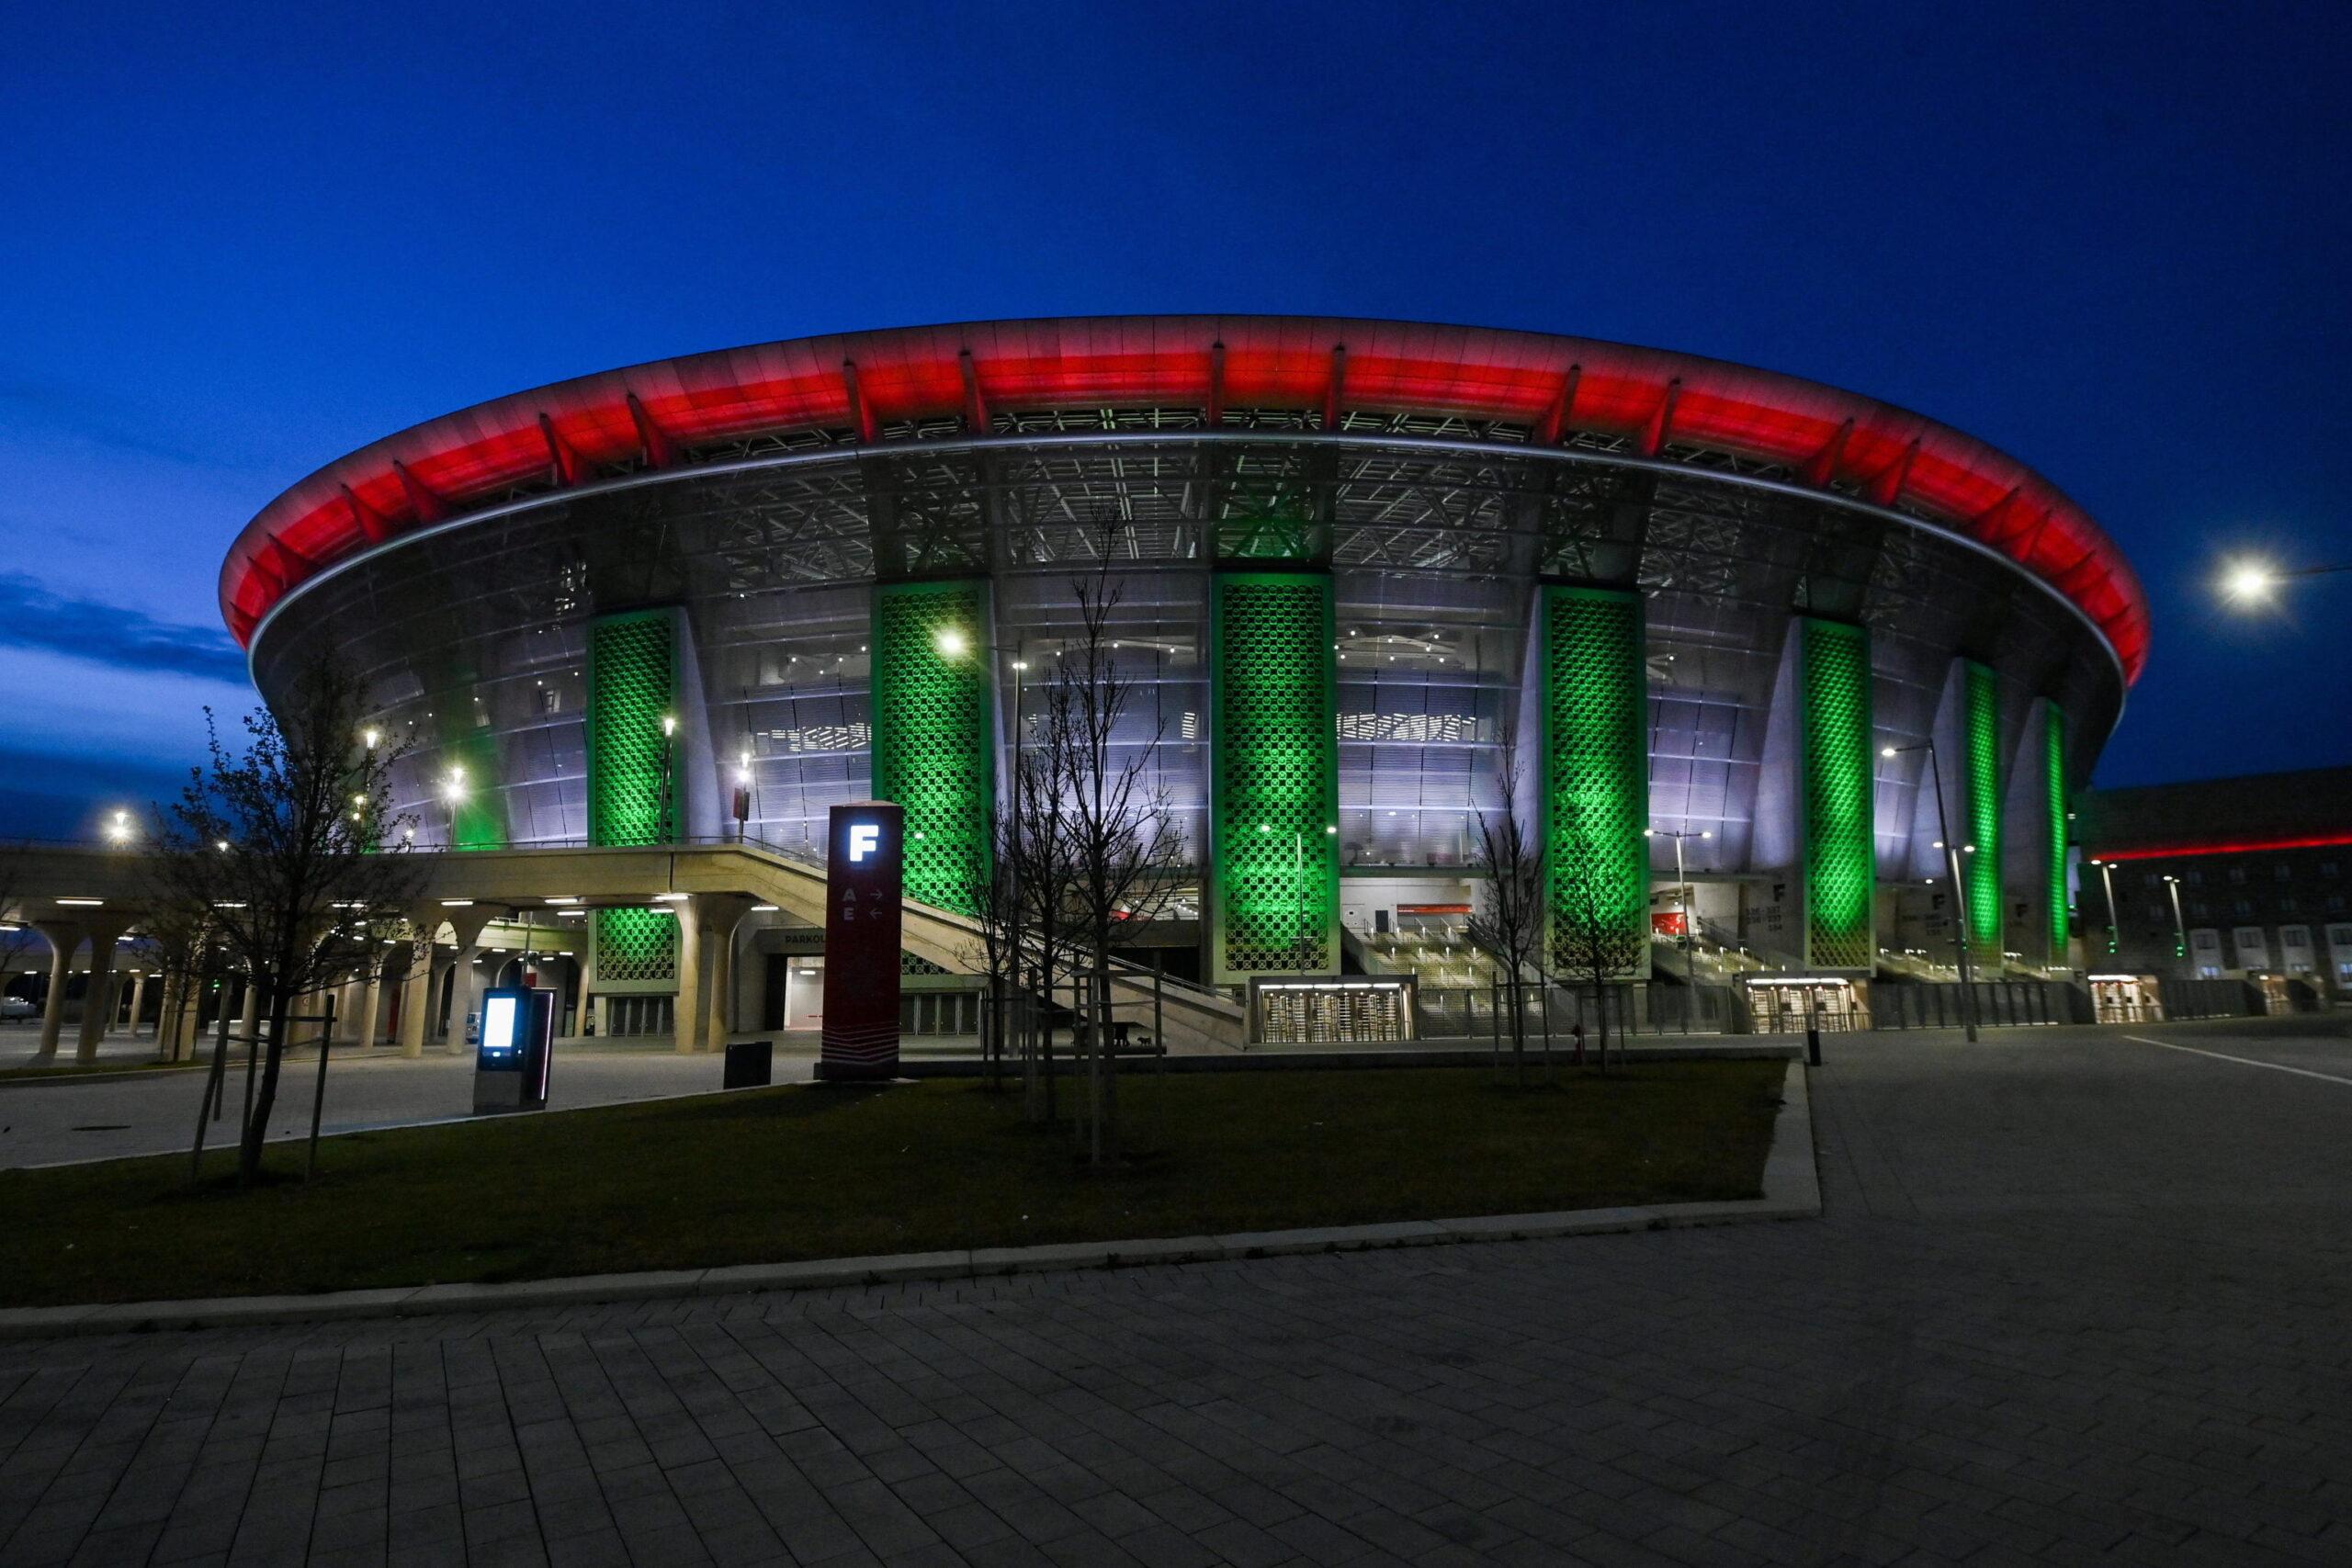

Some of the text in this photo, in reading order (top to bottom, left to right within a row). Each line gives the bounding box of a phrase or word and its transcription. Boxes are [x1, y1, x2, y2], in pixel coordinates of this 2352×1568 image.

[850, 825, 879, 862] F
[842, 887, 856, 902] A
[1773, 884, 1785, 902] F
[1932, 895, 1945, 910] F
[843, 906, 854, 921] E
